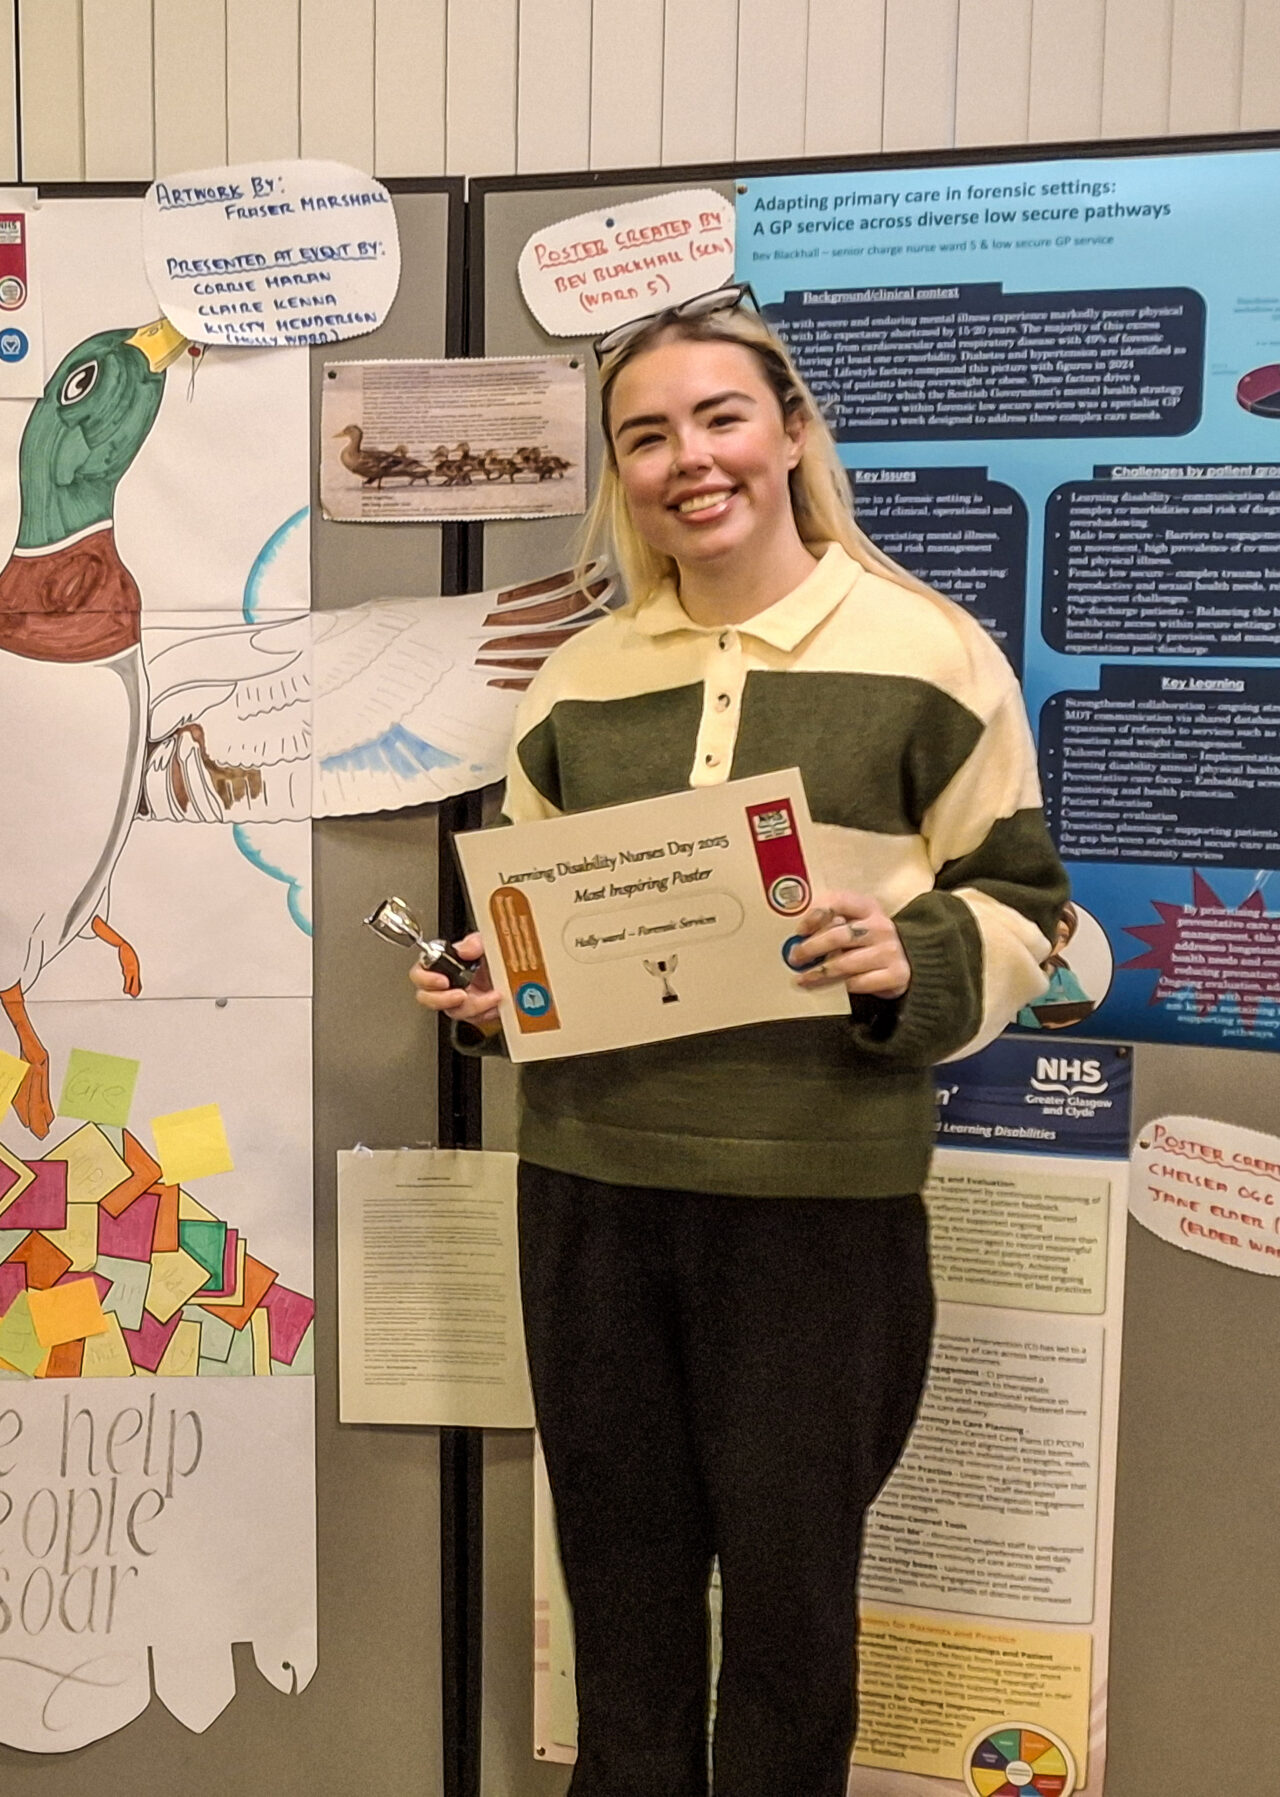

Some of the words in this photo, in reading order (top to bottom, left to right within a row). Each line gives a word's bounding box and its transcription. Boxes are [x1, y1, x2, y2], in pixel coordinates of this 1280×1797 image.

[155, 183, 244, 205] ARTWORK
[225, 204, 295, 221] FRASER
[301, 193, 389, 212] MARSHALL
[754, 193, 828, 213] Adapting
[834, 191, 900, 210] primary
[905, 189, 940, 203] care
[946, 186, 961, 200] in
[967, 182, 1036, 199] forensic
[1041, 179, 1116, 197] settings:
[753, 222, 765, 236] A
[770, 220, 793, 235] GP
[797, 217, 855, 233] service
[860, 215, 912, 230] across
[917, 211, 979, 226] diverse
[984, 208, 1017, 223] low
[1022, 206, 1079, 221] secure
[1085, 202, 1171, 222] pathways
[534, 239, 608, 265] POSTER
[616, 219, 692, 246] CREATED
[753, 251, 771, 262] Bev
[774, 248, 820, 260] Blackhall
[832, 247, 864, 257] senior
[868, 244, 903, 257] charge
[906, 243, 937, 253] nurse
[939, 240, 967, 251] ward
[980, 239, 989, 250] &
[992, 238, 1012, 249] low
[1016, 237, 1053, 248] secure
[1055, 236, 1072, 247] GP
[1074, 235, 1115, 246] service
[166, 253, 267, 276] PRESENTED
[274, 249, 293, 264] AT
[300, 242, 351, 260] EVENT
[554, 271, 587, 293] BEV
[594, 251, 683, 283] BLACKHALL
[193, 279, 256, 295] CORRIE
[579, 287, 639, 313] (WARD
[647, 273, 671, 296] 5)
[803, 288, 915, 304] Background/clinical
[917, 286, 960, 300] context
[198, 301, 263, 317] CLAIRE
[274, 294, 338, 312] KENNA
[205, 319, 265, 336] KIRSTY
[276, 312, 377, 331] HENDERSON
[855, 470, 879, 483] Key
[1111, 465, 1184, 481] Challenges
[1187, 465, 1205, 479] by
[1206, 464, 1253, 480] patient
[1161, 677, 1186, 691] Key
[1188, 677, 1245, 692] Learning
[498, 867, 556, 886] Learning
[556, 857, 618, 877] Disability
[619, 848, 665, 865] Nurses
[667, 841, 695, 858] Day
[698, 835, 730, 851] 2025
[573, 886, 607, 904] Most
[609, 876, 670, 898] Inspiring
[672, 868, 714, 886] Poster
[1036, 1056, 1102, 1083] NHS
[1024, 1094, 1066, 1106] Greater
[1068, 1096, 1113, 1109] Glasgow
[1042, 1106, 1063, 1116] and
[1065, 1107, 1095, 1119] Clyde
[943, 1122, 993, 1138] Learning
[994, 1125, 1057, 1141] Disabilities
[1154, 1123, 1225, 1161] POSTER
[1148, 1163, 1228, 1192] CHELSEA
[1147, 1186, 1201, 1213] JANE
[1210, 1205, 1265, 1229] ELDER
[1180, 1216, 1243, 1248] (ELDER
[59, 1393, 204, 1499] help
